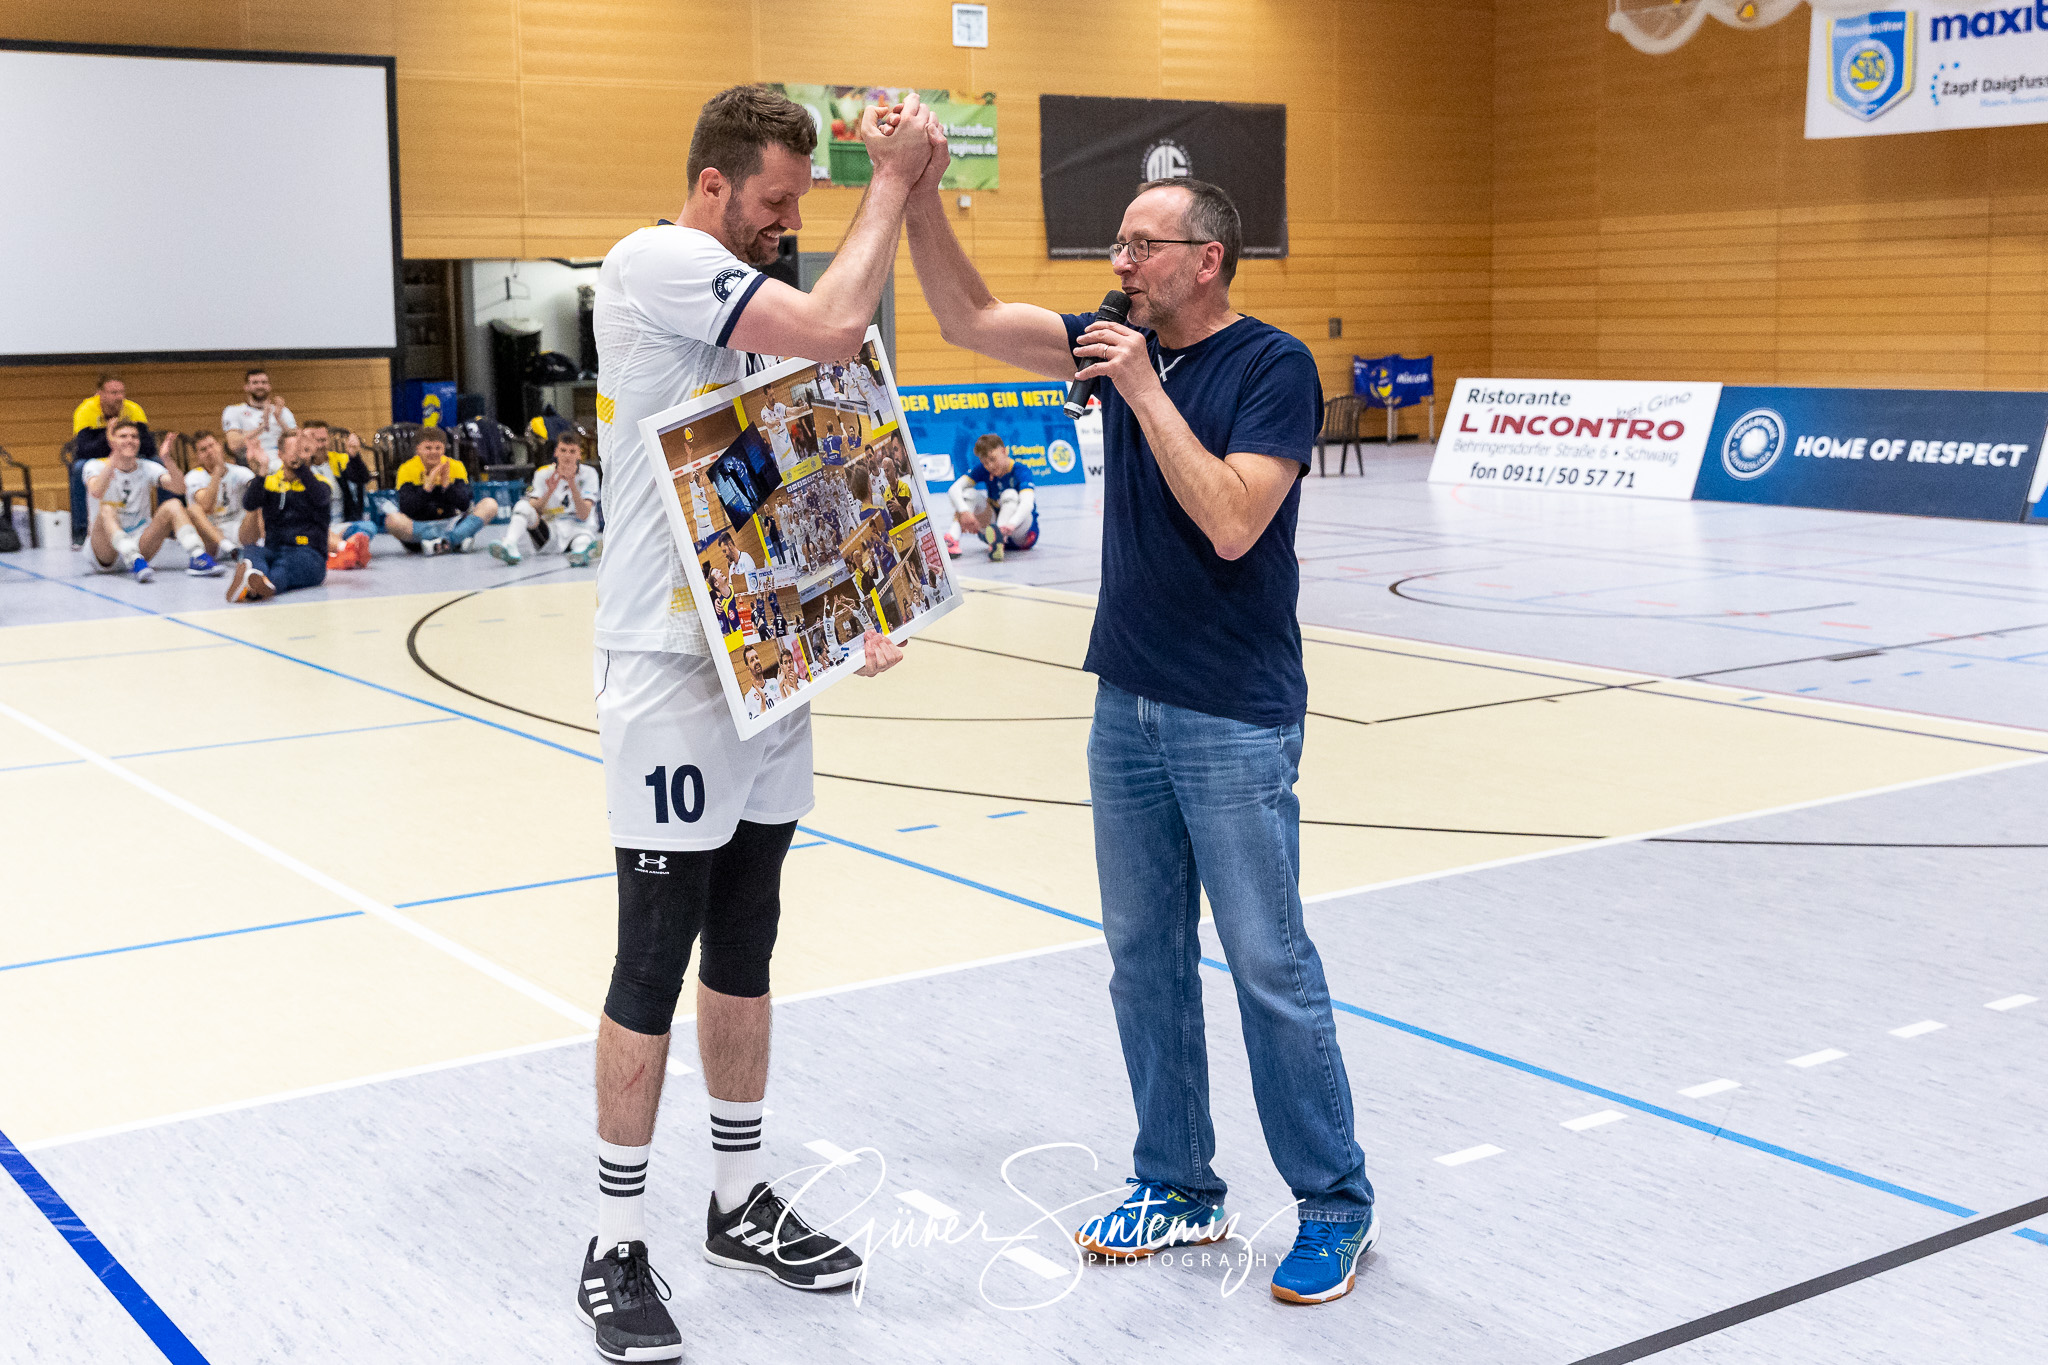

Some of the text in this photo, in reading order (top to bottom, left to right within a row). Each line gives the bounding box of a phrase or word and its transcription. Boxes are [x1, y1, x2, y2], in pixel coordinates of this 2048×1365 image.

[1942, 80, 1978, 97] Zapf
[933, 393, 990, 414] JUGEND
[992, 392, 1019, 408] EIN
[1021, 390, 1065, 406] NETZ!
[1467, 388, 1571, 406] Ristorante
[1647, 391, 1692, 412] Gino
[1453, 438, 1551, 457] Behringersdorfer
[1554, 443, 1596, 459] Straße
[1623, 446, 1679, 467] Schwaig
[1793, 435, 2029, 467] HOME OF RESPECT
[1471, 462, 1635, 488] fon 0911/50 57 71
[645, 764, 706, 823] 10
